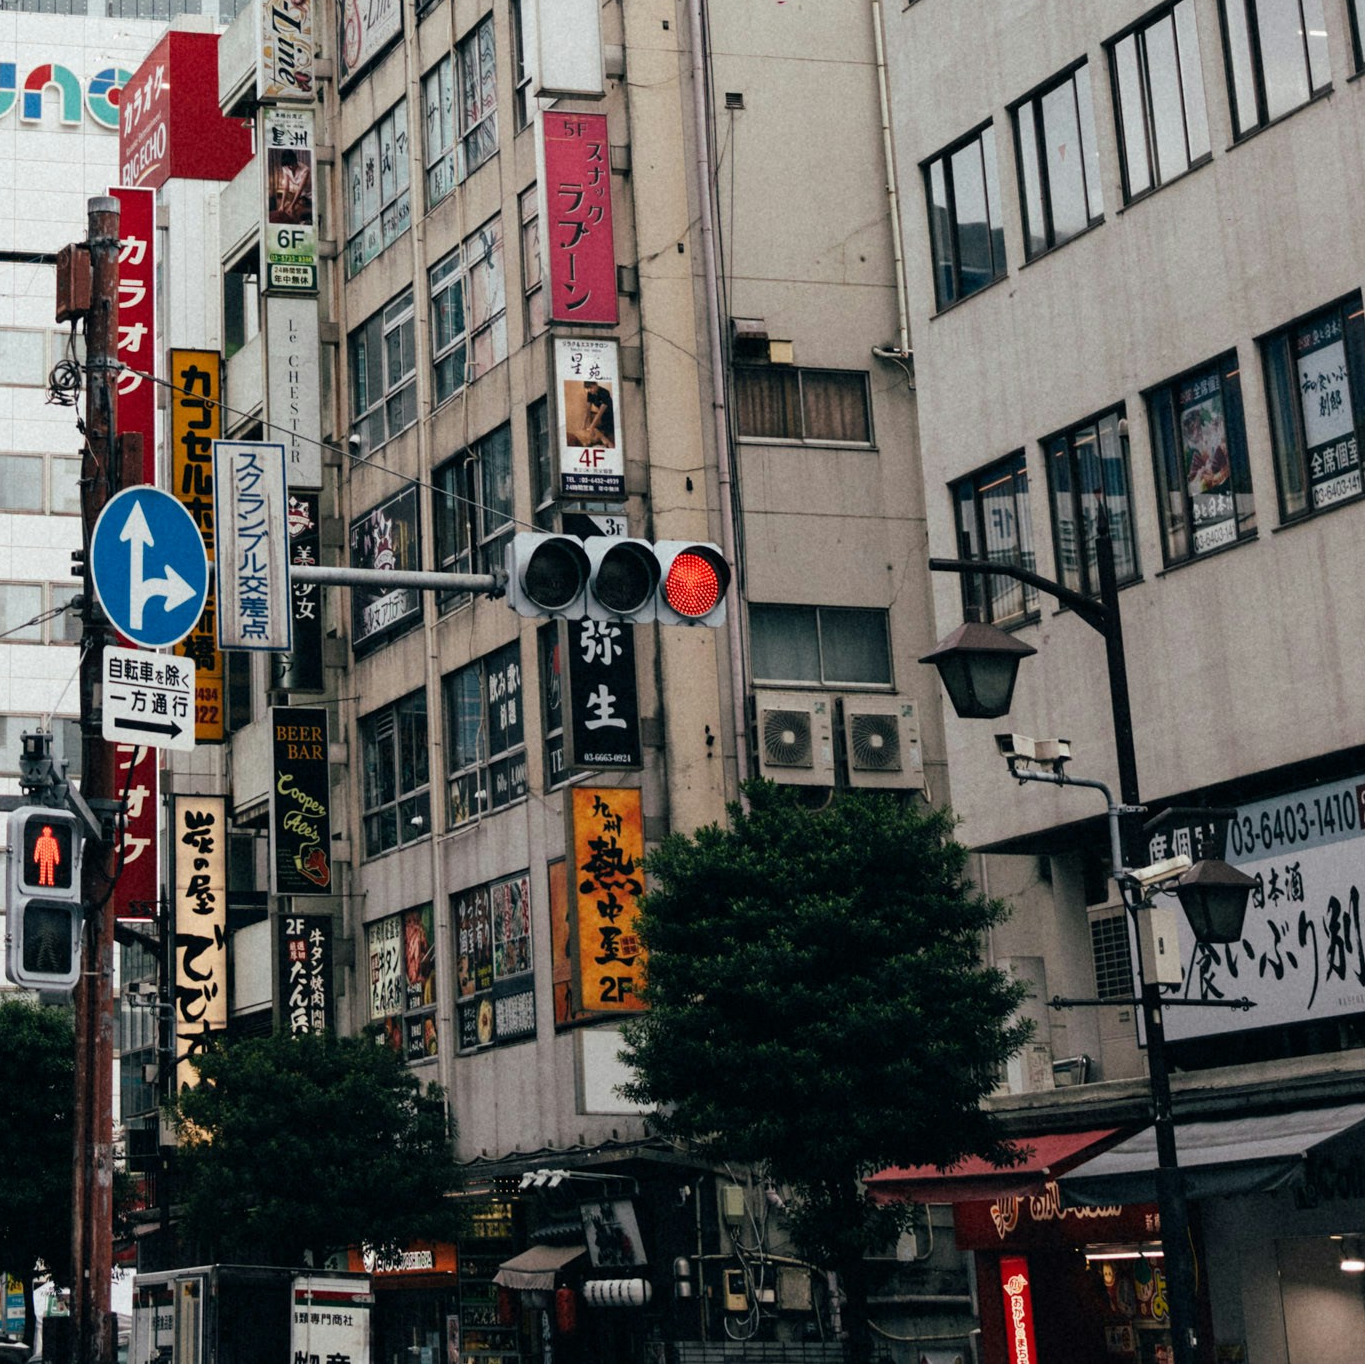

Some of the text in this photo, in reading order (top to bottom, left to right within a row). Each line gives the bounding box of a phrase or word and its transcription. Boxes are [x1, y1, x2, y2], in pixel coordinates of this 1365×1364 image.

[124, 64, 164, 138] カラオケ
[140, 122, 167, 170] ECHO
[564, 121, 587, 137] 5F
[586, 143, 606, 225] スナック
[277, 229, 305, 249] 6F
[274, 274, 309, 285] 年中無休
[118, 236, 148, 396] カラオケ
[288, 355, 300, 463] CHESTER
[578, 449, 605, 467] 4F
[181, 365, 215, 671] カプセルホ橋
[606, 519, 625, 536] 3F
[236, 452, 270, 640] スクランブル交差点
[109, 656, 190, 688] 自転車を除く
[579, 619, 628, 731] 弥生
[109, 689, 188, 718] 一方通行
[276, 725, 323, 742] BEER
[288, 744, 324, 760] BAR
[550, 748, 565, 774] TE
[116, 744, 151, 865] ラオケ
[277, 770, 327, 817] Cooper
[592, 794, 624, 838] 九州
[1231, 790, 1357, 857] 03-6403-1410
[182, 810, 216, 915] 炭の屋
[286, 918, 305, 935] 2F
[1182, 885, 1365, 1011] 食いぶり別
[309, 927, 326, 1008] 牛タン焼肉
[599, 975, 634, 1003] 2F
[289, 960, 310, 1036] たん兵
[295, 1312, 354, 1327] 類専門商社
